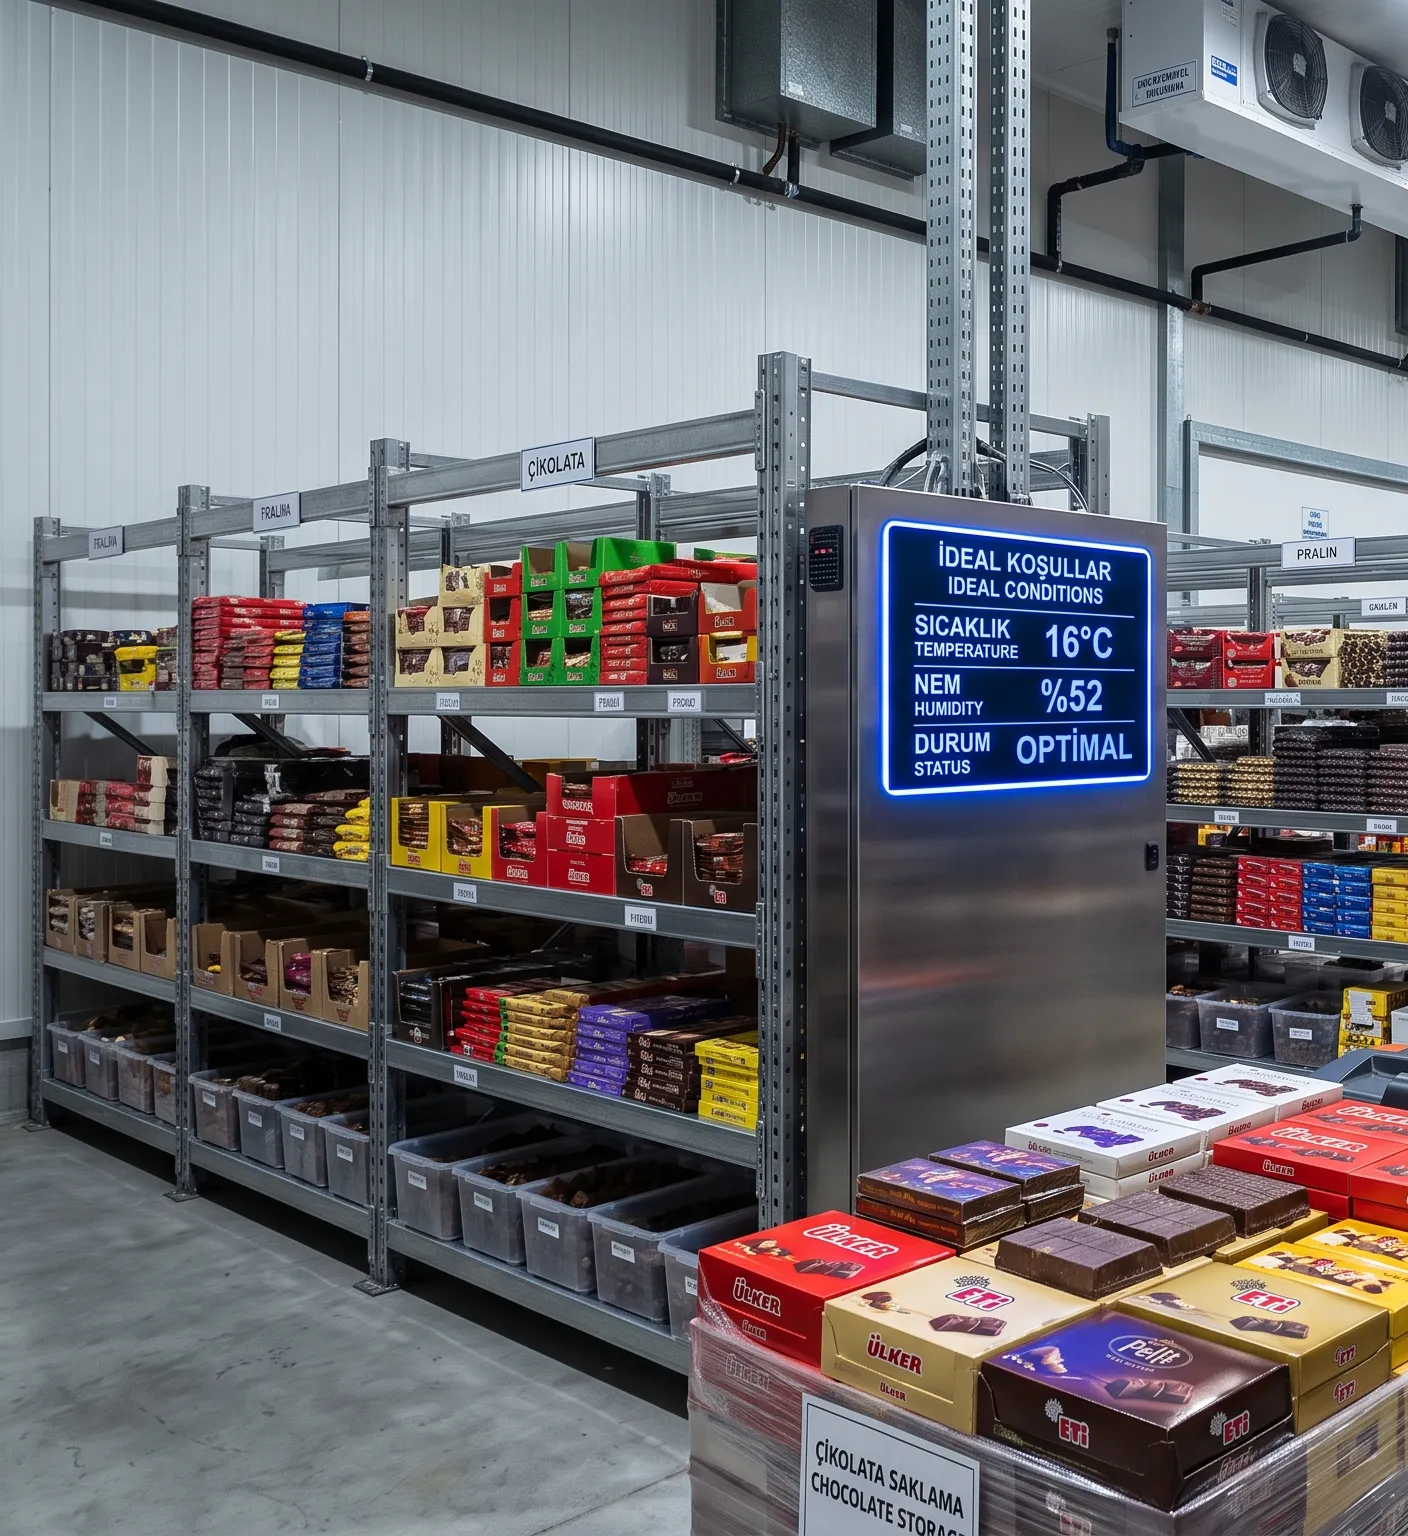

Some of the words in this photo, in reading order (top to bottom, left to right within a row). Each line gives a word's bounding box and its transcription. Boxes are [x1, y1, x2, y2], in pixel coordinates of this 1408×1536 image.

[528, 451, 585, 482] ÇİKOLATA
[939, 540, 1001, 573] İDEAL
[1007, 552, 1112, 582] KOŞULLAR
[1297, 546, 1337, 560] PRALIN
[948, 576, 1000, 598] IDEAL
[1004, 580, 1103, 605] CONDITIONS
[914, 614, 1011, 639] SICAKLIK
[1045, 624, 1113, 659] 16°C
[914, 641, 1019, 659] TEMPERATURE
[914, 674, 961, 695] NEM
[1041, 678, 1103, 713] %52
[914, 701, 984, 716] HUMIDITY
[914, 732, 991, 754] DURUM
[1016, 727, 1133, 765] OPTİMAL
[914, 760, 971, 776] STATUS
[803, 1223, 899, 1260] ÜLKER
[733, 1277, 781, 1317] ÜLKER
[866, 1332, 923, 1377] ÜLKER
[815, 1438, 885, 1487] ÇİKOLATA
[889, 1469, 964, 1519] SAKLAMA
[811, 1471, 894, 1524] CHOCOLATE
[897, 1507, 965, 1536] STORA
